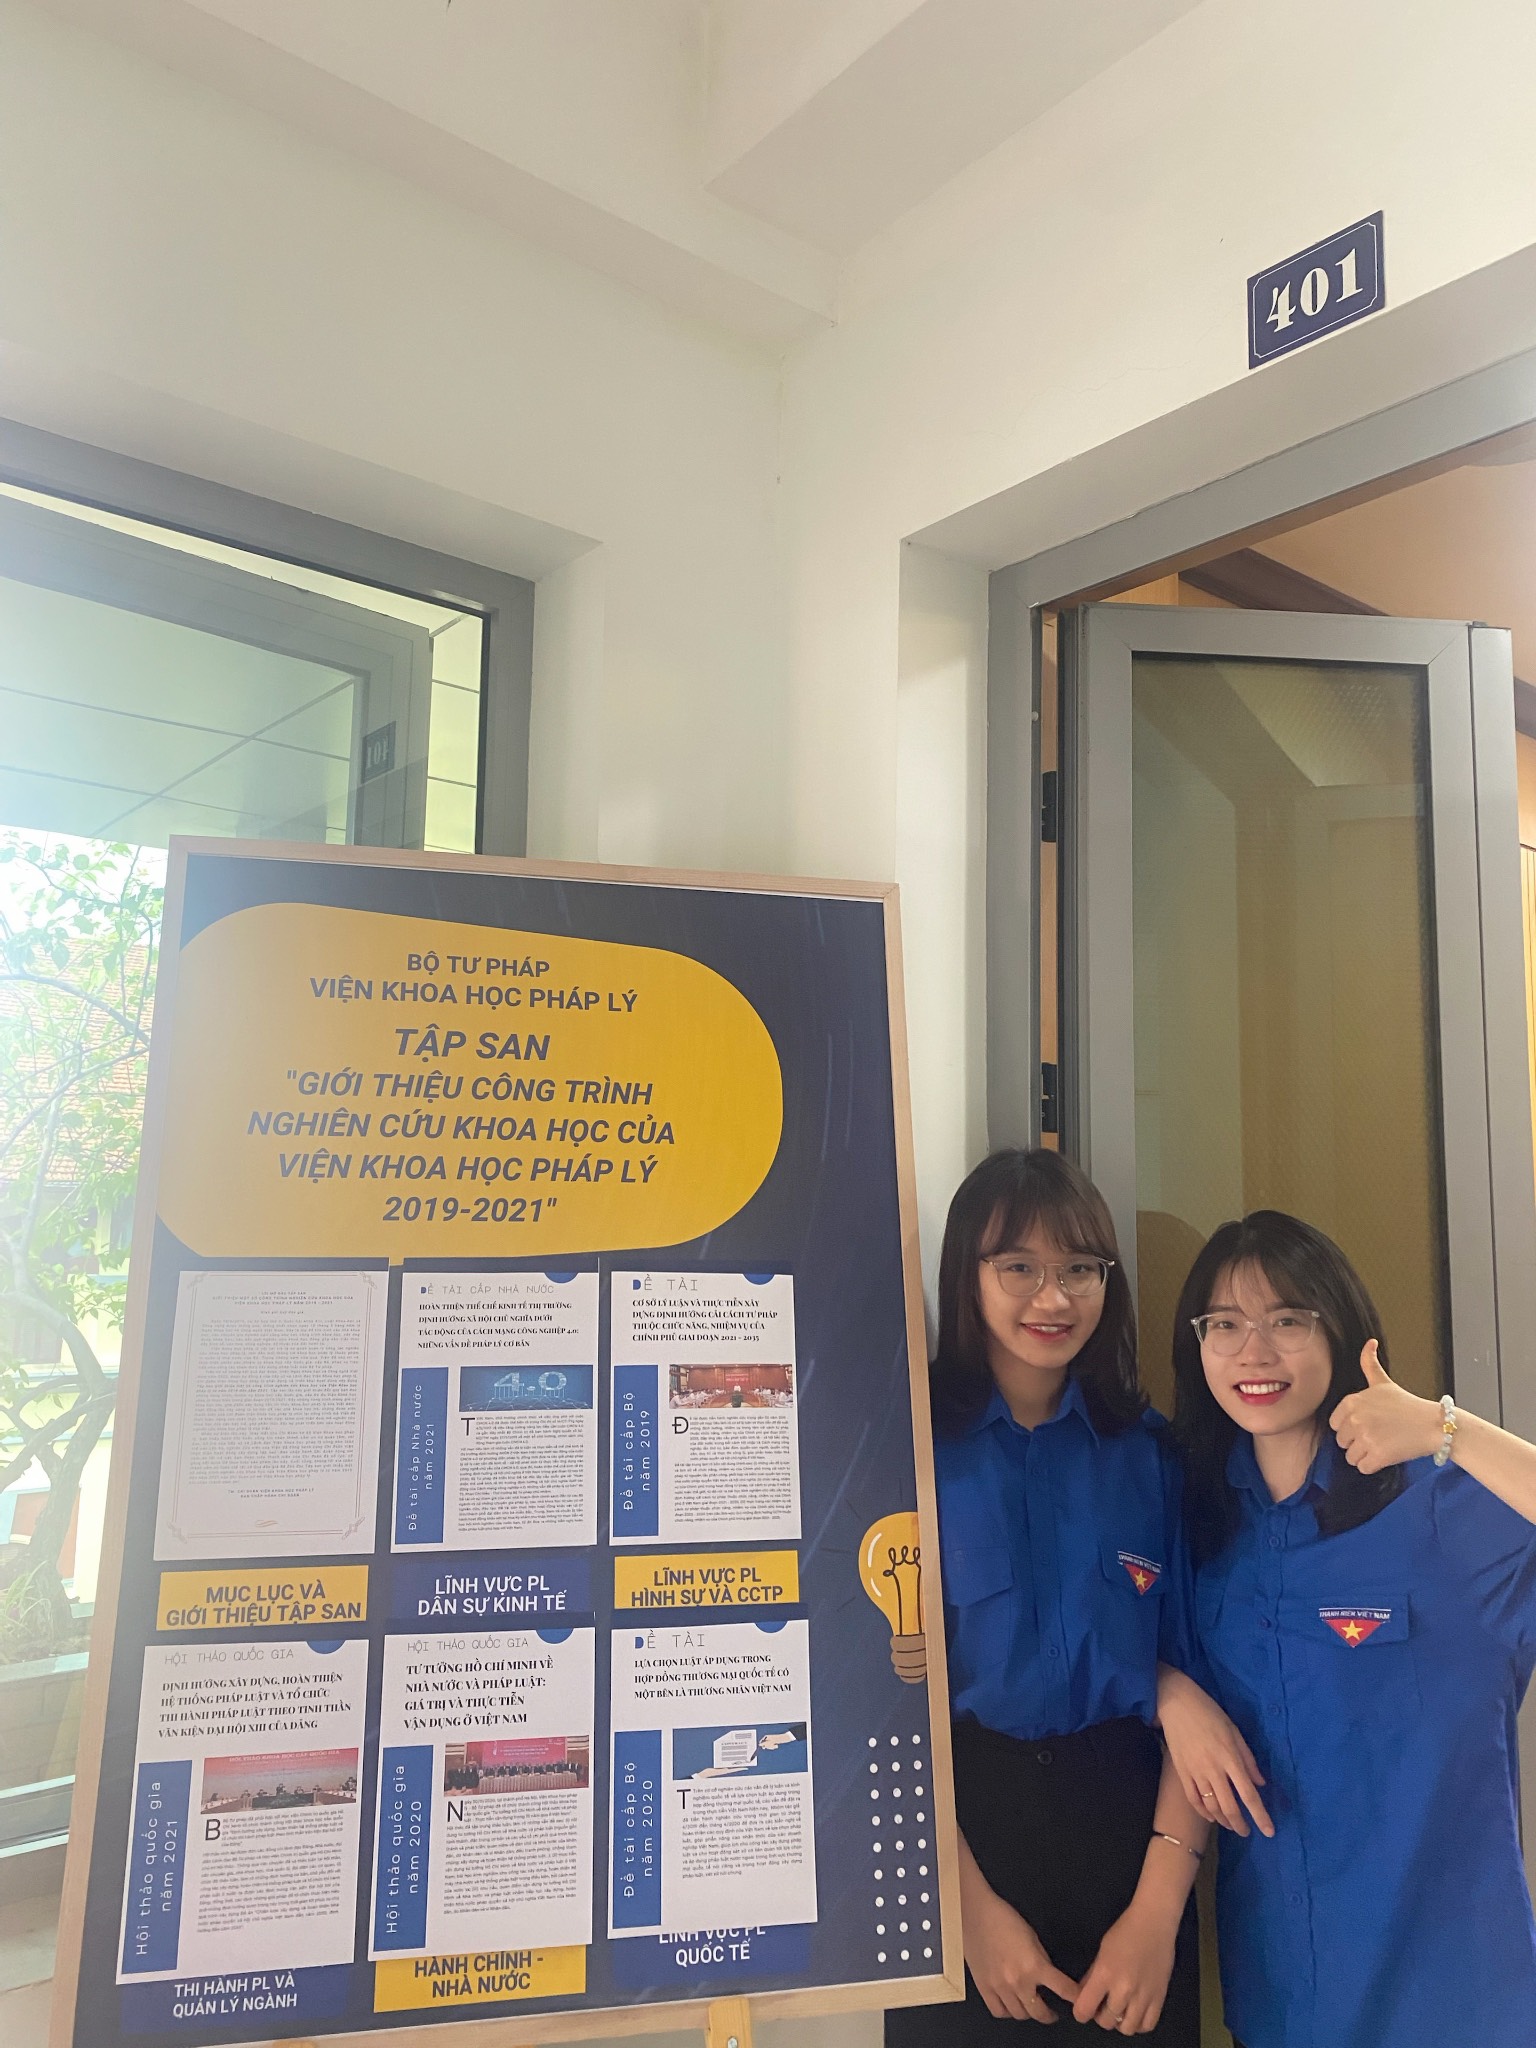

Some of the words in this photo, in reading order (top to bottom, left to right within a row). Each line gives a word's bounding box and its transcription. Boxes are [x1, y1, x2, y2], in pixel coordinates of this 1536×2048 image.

[1266, 248, 1363, 333] 401
[406, 951, 440, 976] BỘ
[446, 955, 481, 975] TƯ
[485, 954, 550, 977] PHÁP
[309, 976, 375, 1004] VIỆN
[381, 981, 457, 1002] KHOA
[465, 984, 522, 1010] HỌC
[529, 984, 601, 1010] PHÁP
[607, 989, 638, 1013] LÝ
[394, 1023, 466, 1063] TẬP
[475, 1033, 551, 1061] SAN
[286, 1068, 364, 1098] "GIỚI
[374, 1070, 463, 1104] THIỆU
[470, 1072, 556, 1103] CÔNG
[564, 1075, 652, 1105] TRÌNH
[247, 1107, 371, 1136] NGHIÊN
[379, 1110, 449, 1140] CỨU
[453, 1115, 538, 1140] KHOA
[546, 1117, 609, 1148] HỌC
[616, 1114, 675, 1145] CỦA
[277, 1148, 350, 1186] VIỆN
[359, 1155, 447, 1180] KHOA
[455, 1156, 522, 1188] HỌC
[529, 1153, 613, 1183] PHÁP
[621, 1153, 658, 1183] LÝ
[382, 1196, 558, 1223] 2019-2021"
[470, 1283, 491, 1294] CẤP
[499, 1285, 519, 1294] NHÀ
[527, 1284, 554, 1294] NƯỚC
[667, 1277, 698, 1291] TÀI
[494, 1371, 567, 1391] 4.0
[411, 1385, 422, 1417] nước
[623, 1393, 635, 1410] Bộ
[412, 1425, 420, 1449] Nhà
[425, 1424, 434, 1454] 2021
[620, 1420, 635, 1449] cấp
[640, 1410, 650, 1448] 2019
[408, 1457, 420, 1481] cấp
[623, 1458, 633, 1480] tài
[640, 1457, 650, 1491] năm
[410, 1488, 418, 1506] tài
[620, 1489, 633, 1511] Đề
[406, 1514, 417, 1530] Đề
[435, 1575, 478, 1595] LĨNH
[484, 1576, 522, 1595] VỰC
[528, 1575, 550, 1591] PL
[654, 1567, 694, 1586] LĨNH
[699, 1568, 735, 1587] VỰC
[740, 1568, 761, 1582] PL
[206, 1586, 250, 1605] MỤC
[257, 1584, 294, 1604] LỤC
[300, 1579, 326, 1599] VÀ
[418, 1596, 457, 1615] DÂN
[462, 1597, 489, 1616] SỰ
[494, 1596, 537, 1613] KINH
[543, 1590, 567, 1610] TẾ
[631, 1588, 675, 1606] HÌNH
[680, 1589, 705, 1606] SỰ
[709, 1584, 733, 1604] VÀ
[738, 1586, 783, 1602] CCTP
[166, 1605, 207, 1626] GIỚI
[213, 1603, 270, 1626] THIỆU
[277, 1601, 315, 1624] TẬP
[321, 1602, 361, 1619] SAN
[407, 1639, 429, 1654] HỘI
[437, 1639, 465, 1650] THẢO
[472, 1635, 500, 1649] QUỐC
[507, 1637, 528, 1647] GIA
[672, 1631, 705, 1648] TÀI
[165, 1652, 187, 1668] HỘI
[234, 1646, 264, 1661] QUỐC
[271, 1648, 294, 1659] GIA
[507, 1659, 537, 1670] MINH
[741, 1655, 771, 1664] TRONG
[465, 1679, 480, 1690] VÀ
[483, 1677, 512, 1689] PHÁP
[449, 1696, 463, 1709] VÀ
[502, 1713, 527, 1723] NAM
[393, 1765, 406, 1792] gia
[624, 1762, 637, 1783] Bộ
[149, 1782, 162, 1810] gia
[642, 1780, 653, 1827] 2020
[621, 1793, 637, 1827] cấp
[388, 1801, 403, 1846] quốc
[409, 1801, 422, 1846] 2020
[141, 1818, 158, 1865] quốc
[163, 1821, 178, 1863] 2021
[624, 1837, 635, 1863] tài
[642, 1837, 653, 1877] năm
[387, 1854, 400, 1896] thảo
[407, 1856, 419, 1894] năm
[621, 1873, 635, 1898] Đề
[139, 1873, 154, 1916] thảo
[160, 1872, 174, 1911] năm
[386, 1904, 400, 1933] Hội
[135, 1926, 149, 1955] Hội
[676, 1941, 724, 1967] QUỐC
[729, 1938, 750, 1960] TẾ
[415, 1956, 467, 1978] HÀNH
[175, 1982, 199, 1997] THI
[204, 1978, 247, 1995] HÀNH
[252, 1977, 270, 1991] PL
[275, 1971, 295, 1988] VÀ
[433, 1974, 472, 1998] NHÀ
[478, 1970, 530, 1993] NƯỚC
[173, 1997, 216, 2018] QUẢN
[221, 1995, 238, 2013] LÝ
[243, 1992, 297, 2011] NGÀNH
